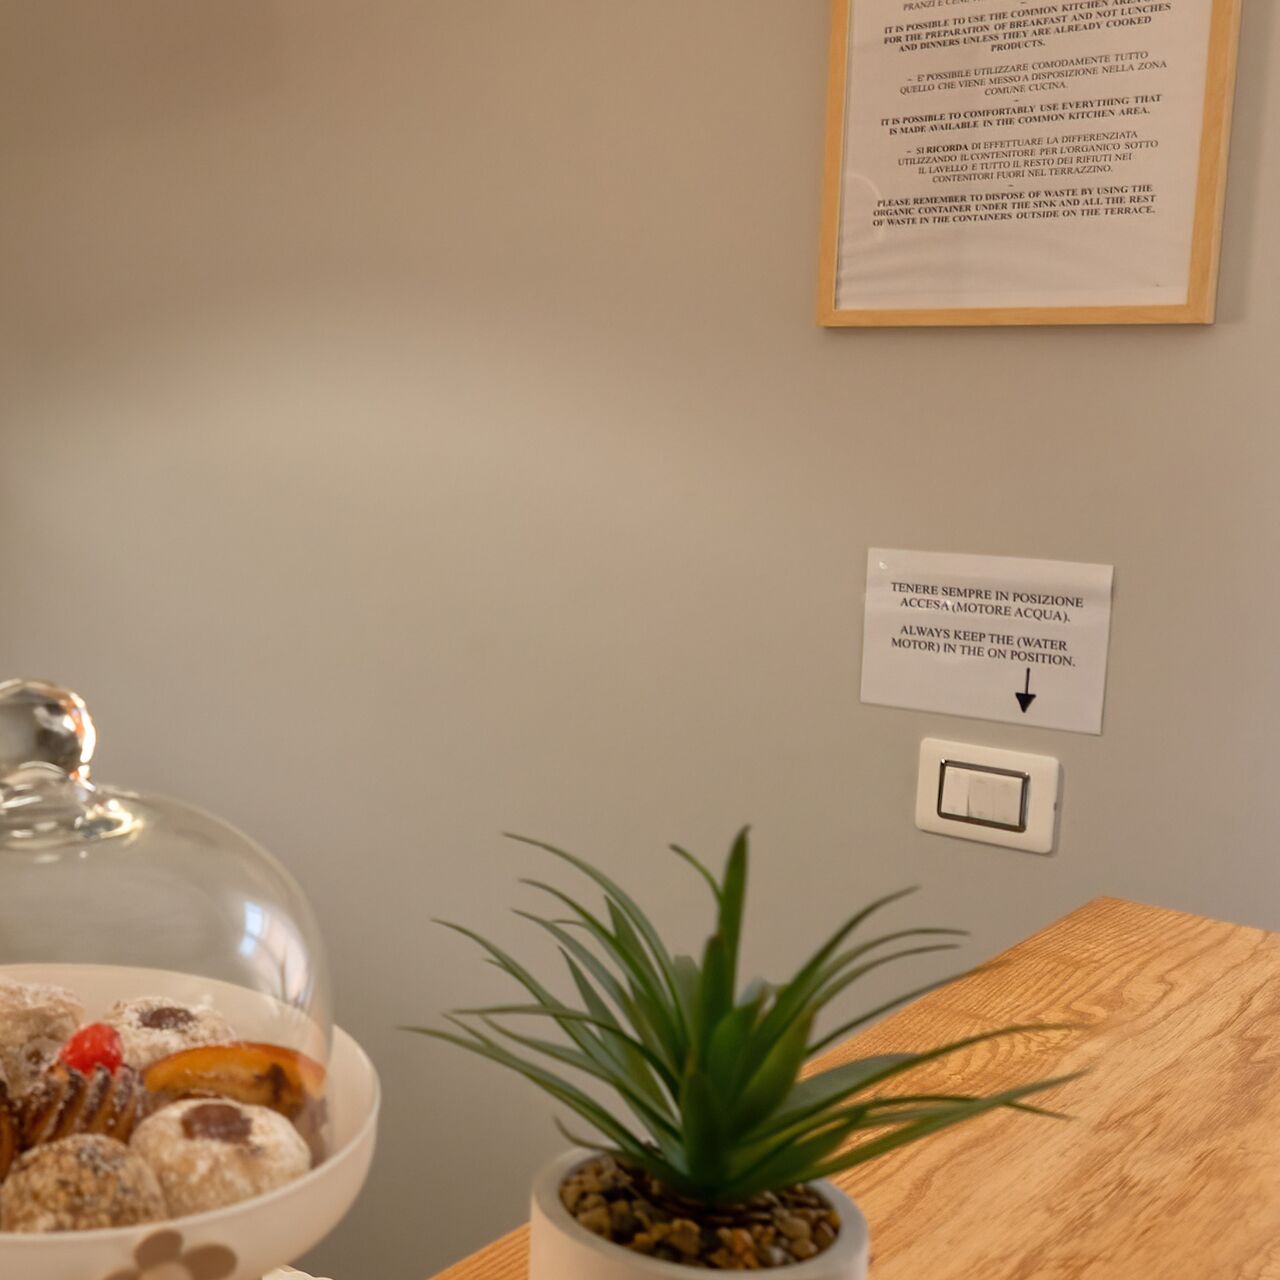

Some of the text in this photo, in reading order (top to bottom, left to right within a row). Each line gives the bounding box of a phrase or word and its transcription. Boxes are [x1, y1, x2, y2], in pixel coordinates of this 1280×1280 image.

[903, 0, 935, 10] PRANZI
[906, 19, 949, 31] POSSIBLE
[953, 17, 965, 25] TO
[967, 14, 985, 23] USE
[989, 12, 1007, 21] THE
[1010, 5, 1057, 18] COMMON
[1061, 0, 1108, 12] KITCHEN
[883, 2, 1172, 44] FOR THE PREPARATION OF BREAKFAST AND NOT LUNCHES
[899, 16, 1152, 52] AND DINNERS UNLESS THEY ARE ALREADY COOKED
[899, 60, 1167, 96] QUELLO CHE VIENE MESSO A DISPOSIZIONE NELLA ZONA
[926, 51, 1148, 81] POSSIBILE UTILIZZARE COMODAMENTE TUTTO
[984, 85, 1025, 95] COMUNE
[899, 125, 926, 134] MADE
[929, 121, 978, 131] AVAILABLE
[996, 118, 1015, 126] THE
[1017, 113, 1064, 124] COMMON
[1068, 109, 1115, 120] KITCHEN
[902, 94, 1162, 124] POSSIBLE TO COMFORTABLY USE EVERYTHING THAT
[897, 154, 957, 165] UTILIZZANDO
[970, 149, 1036, 160] CONTENITORE
[1039, 147, 1057, 155] PER
[1124, 140, 1158, 149] SOTTO
[926, 143, 968, 153] RICORDA
[983, 138, 1043, 149] EFFETTUARE
[1061, 130, 1138, 143] DIFFERENZIATA
[929, 164, 968, 173] LAVELLO
[980, 161, 1010, 170] TUTTO
[1012, 160, 1021, 168] IL
[1023, 158, 1054, 167] RESTO
[1056, 157, 1072, 165] DEI
[1075, 154, 1112, 163] RIFIUTI
[1115, 153, 1131, 161] NEI
[932, 172, 993, 182] CONTENITORI
[996, 170, 1024, 178] FUORI
[873, 195, 1156, 216] ORGANIC CONTAINER UNDER THE SINK AND ALL THE REST
[877, 198, 910, 206] PLEASE
[913, 195, 966, 204] REMEMBER
[985, 192, 1024, 200] DISPOSE
[1044, 189, 1078, 197] WASTE
[1097, 186, 1128, 194] USING
[1131, 184, 1152, 192] THE
[952, 213, 1012, 222] CONTAINERS
[1016, 210, 1060, 219] OUTSIDE
[1079, 208, 1100, 216] THE
[1104, 206, 1155, 215] TERRACE.
[891, 582, 1083, 608] TENERE SEMPRE IN POSIZIONE
[900, 597, 1070, 622] ACCESA (MOTORE ACQUA).
[900, 624, 1067, 651] ALWAYS KEEP THE (WATER
[891, 637, 1076, 667] MOTOR) IN THE ON POSITION.
